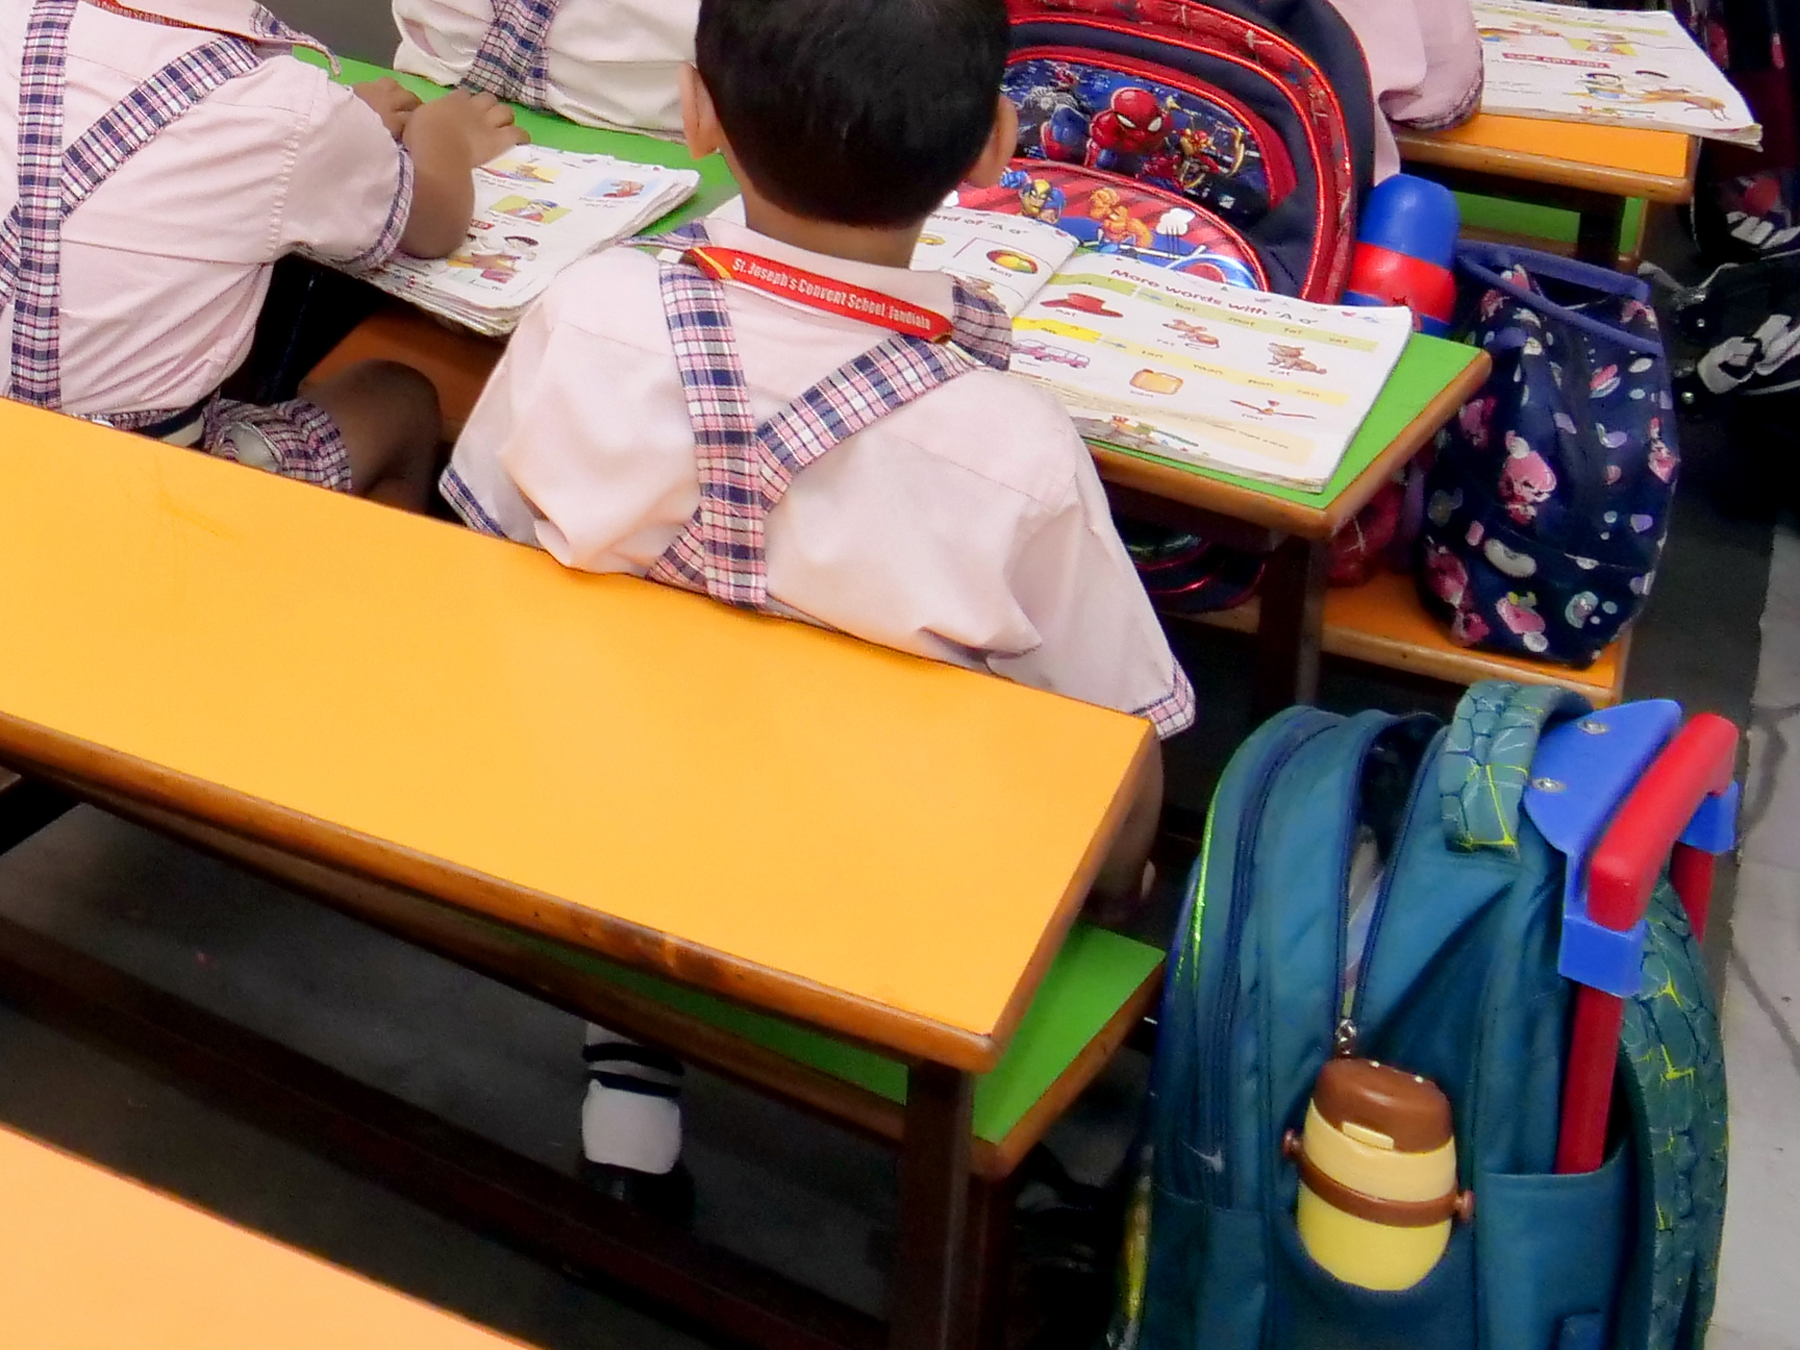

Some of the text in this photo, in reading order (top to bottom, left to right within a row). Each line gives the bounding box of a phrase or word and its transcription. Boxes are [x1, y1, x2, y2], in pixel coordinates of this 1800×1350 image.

[748, 262, 798, 291] Joseph's
[798, 278, 849, 306] Convent
[1111, 268, 1160, 289] More
[1165, 285, 1223, 305] words
[1228, 303, 1268, 316] with
